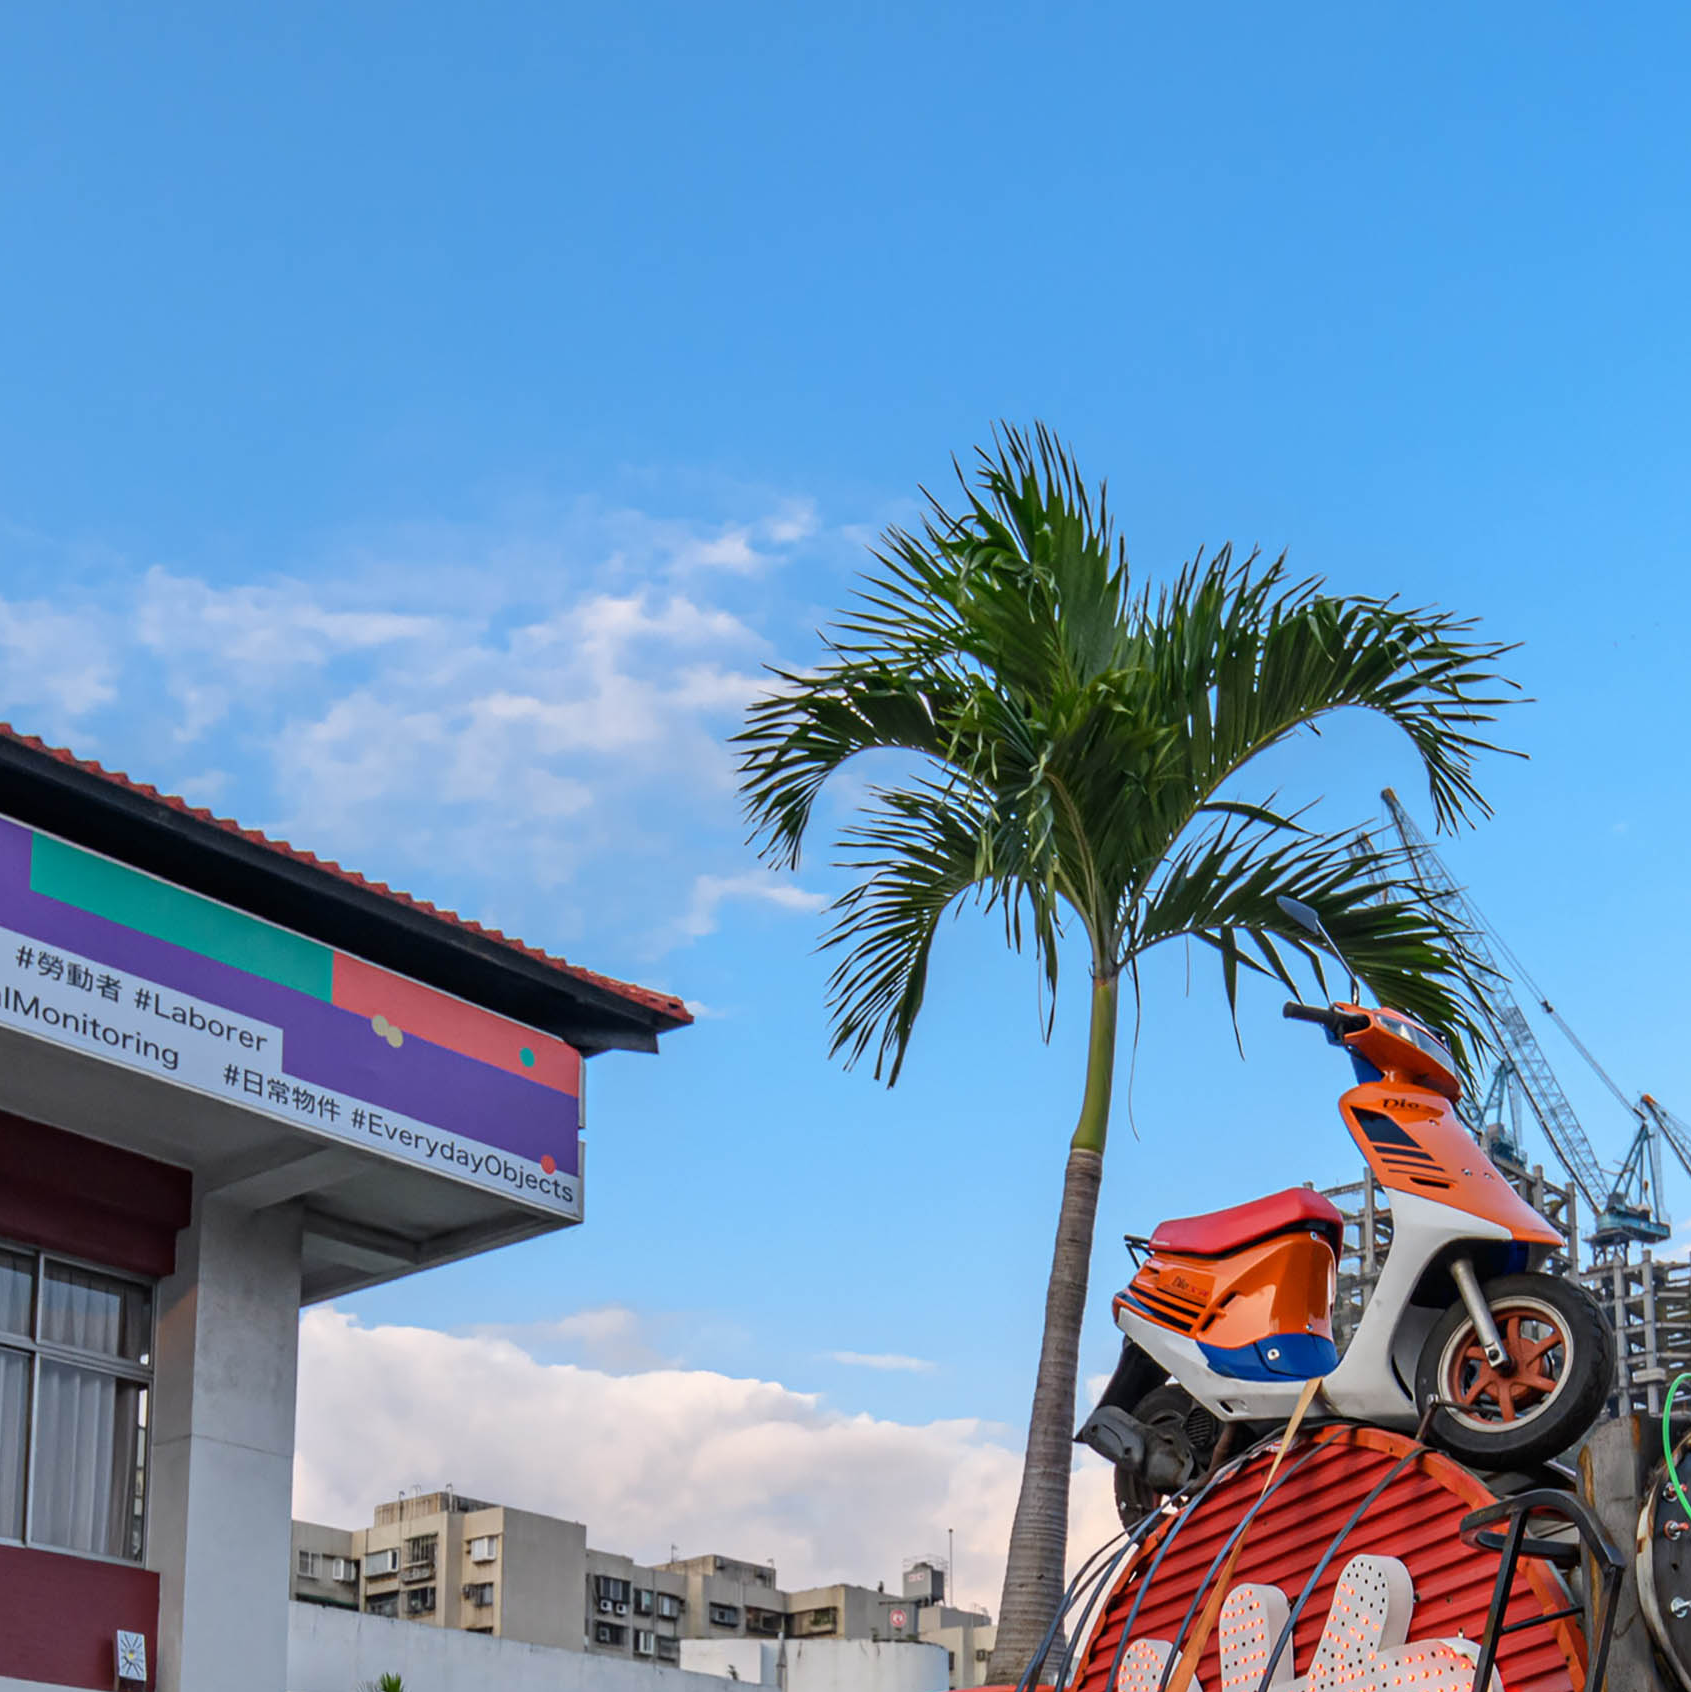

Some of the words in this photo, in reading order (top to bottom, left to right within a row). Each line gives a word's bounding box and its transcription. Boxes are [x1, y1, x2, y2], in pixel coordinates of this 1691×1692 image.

[16, 945, 122, 1003] #勞動者
[134, 988, 267, 1052] #Laborer
[224, 1064, 341, 1122] #日常物件
[351, 1108, 573, 1203] #EverydayObjects
